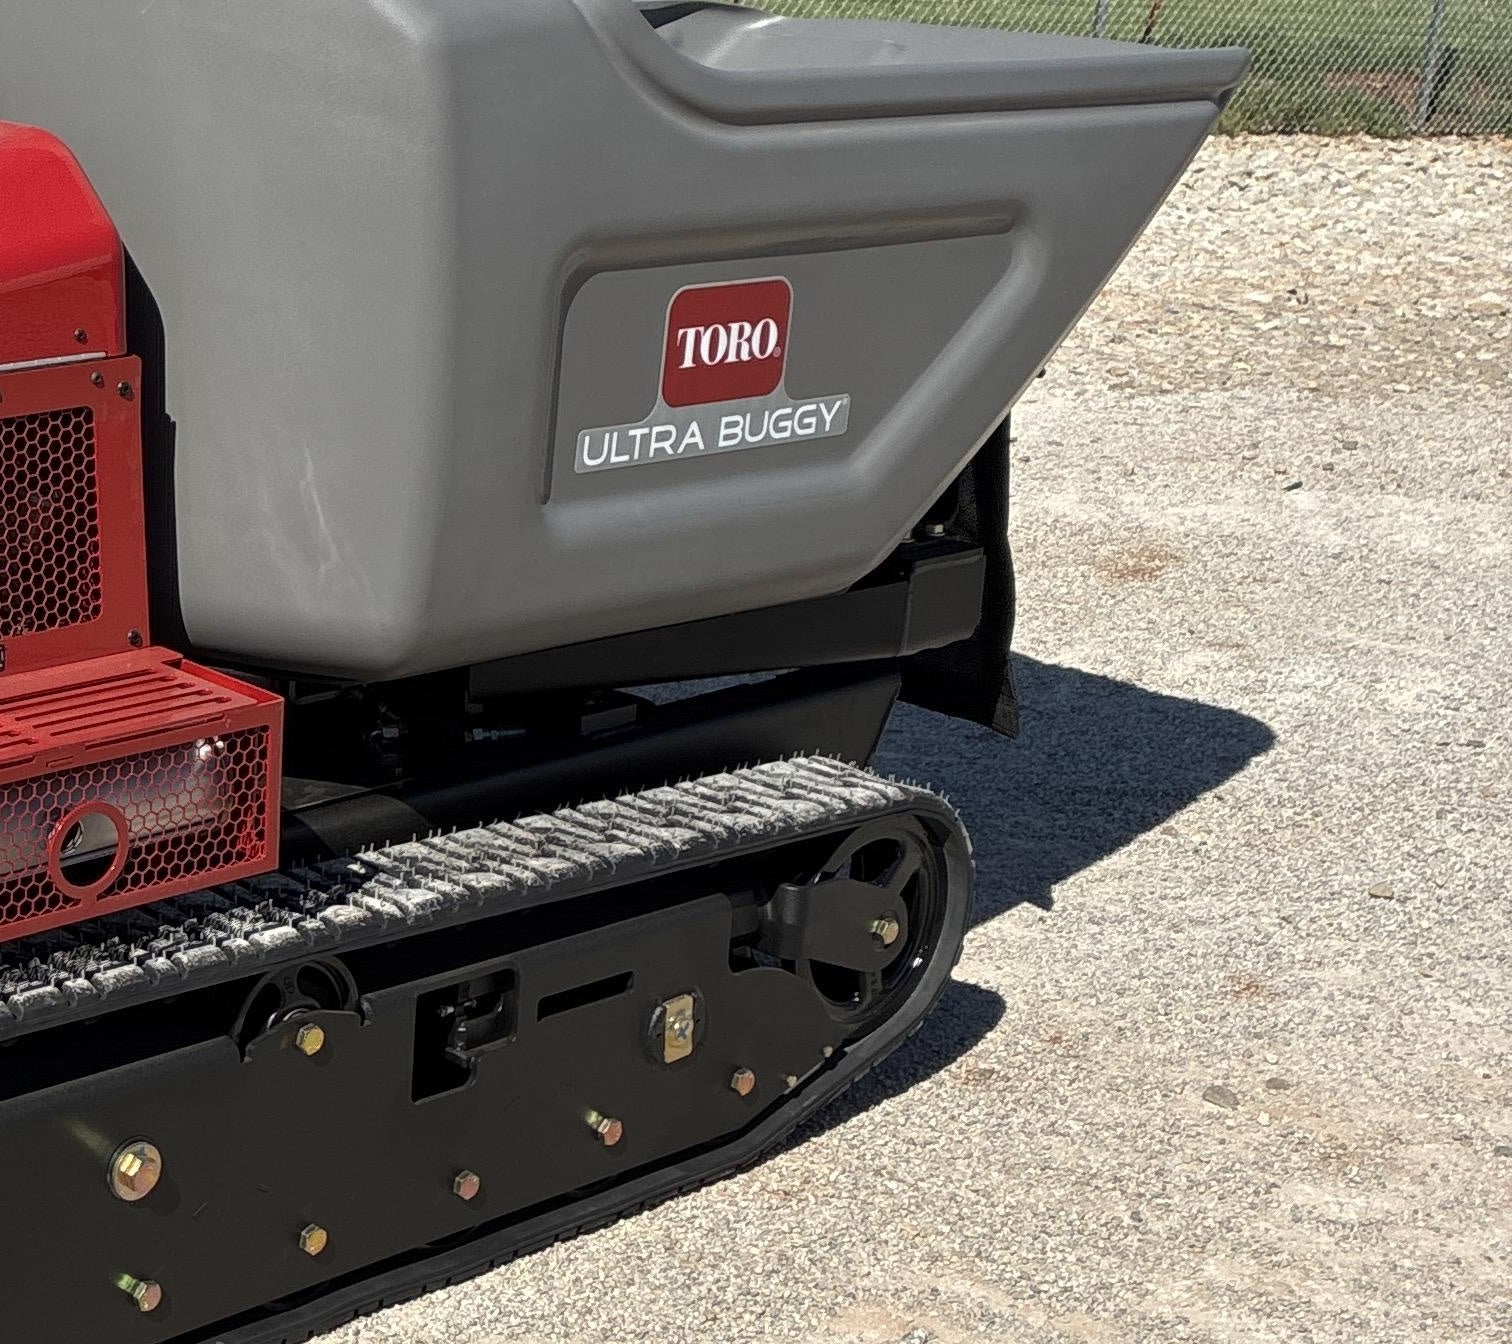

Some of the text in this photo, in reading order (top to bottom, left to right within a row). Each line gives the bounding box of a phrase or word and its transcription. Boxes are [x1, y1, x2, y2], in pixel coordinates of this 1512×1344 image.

[677, 318, 778, 369] TORO
[582, 400, 842, 467] ULTRA BUGGY
